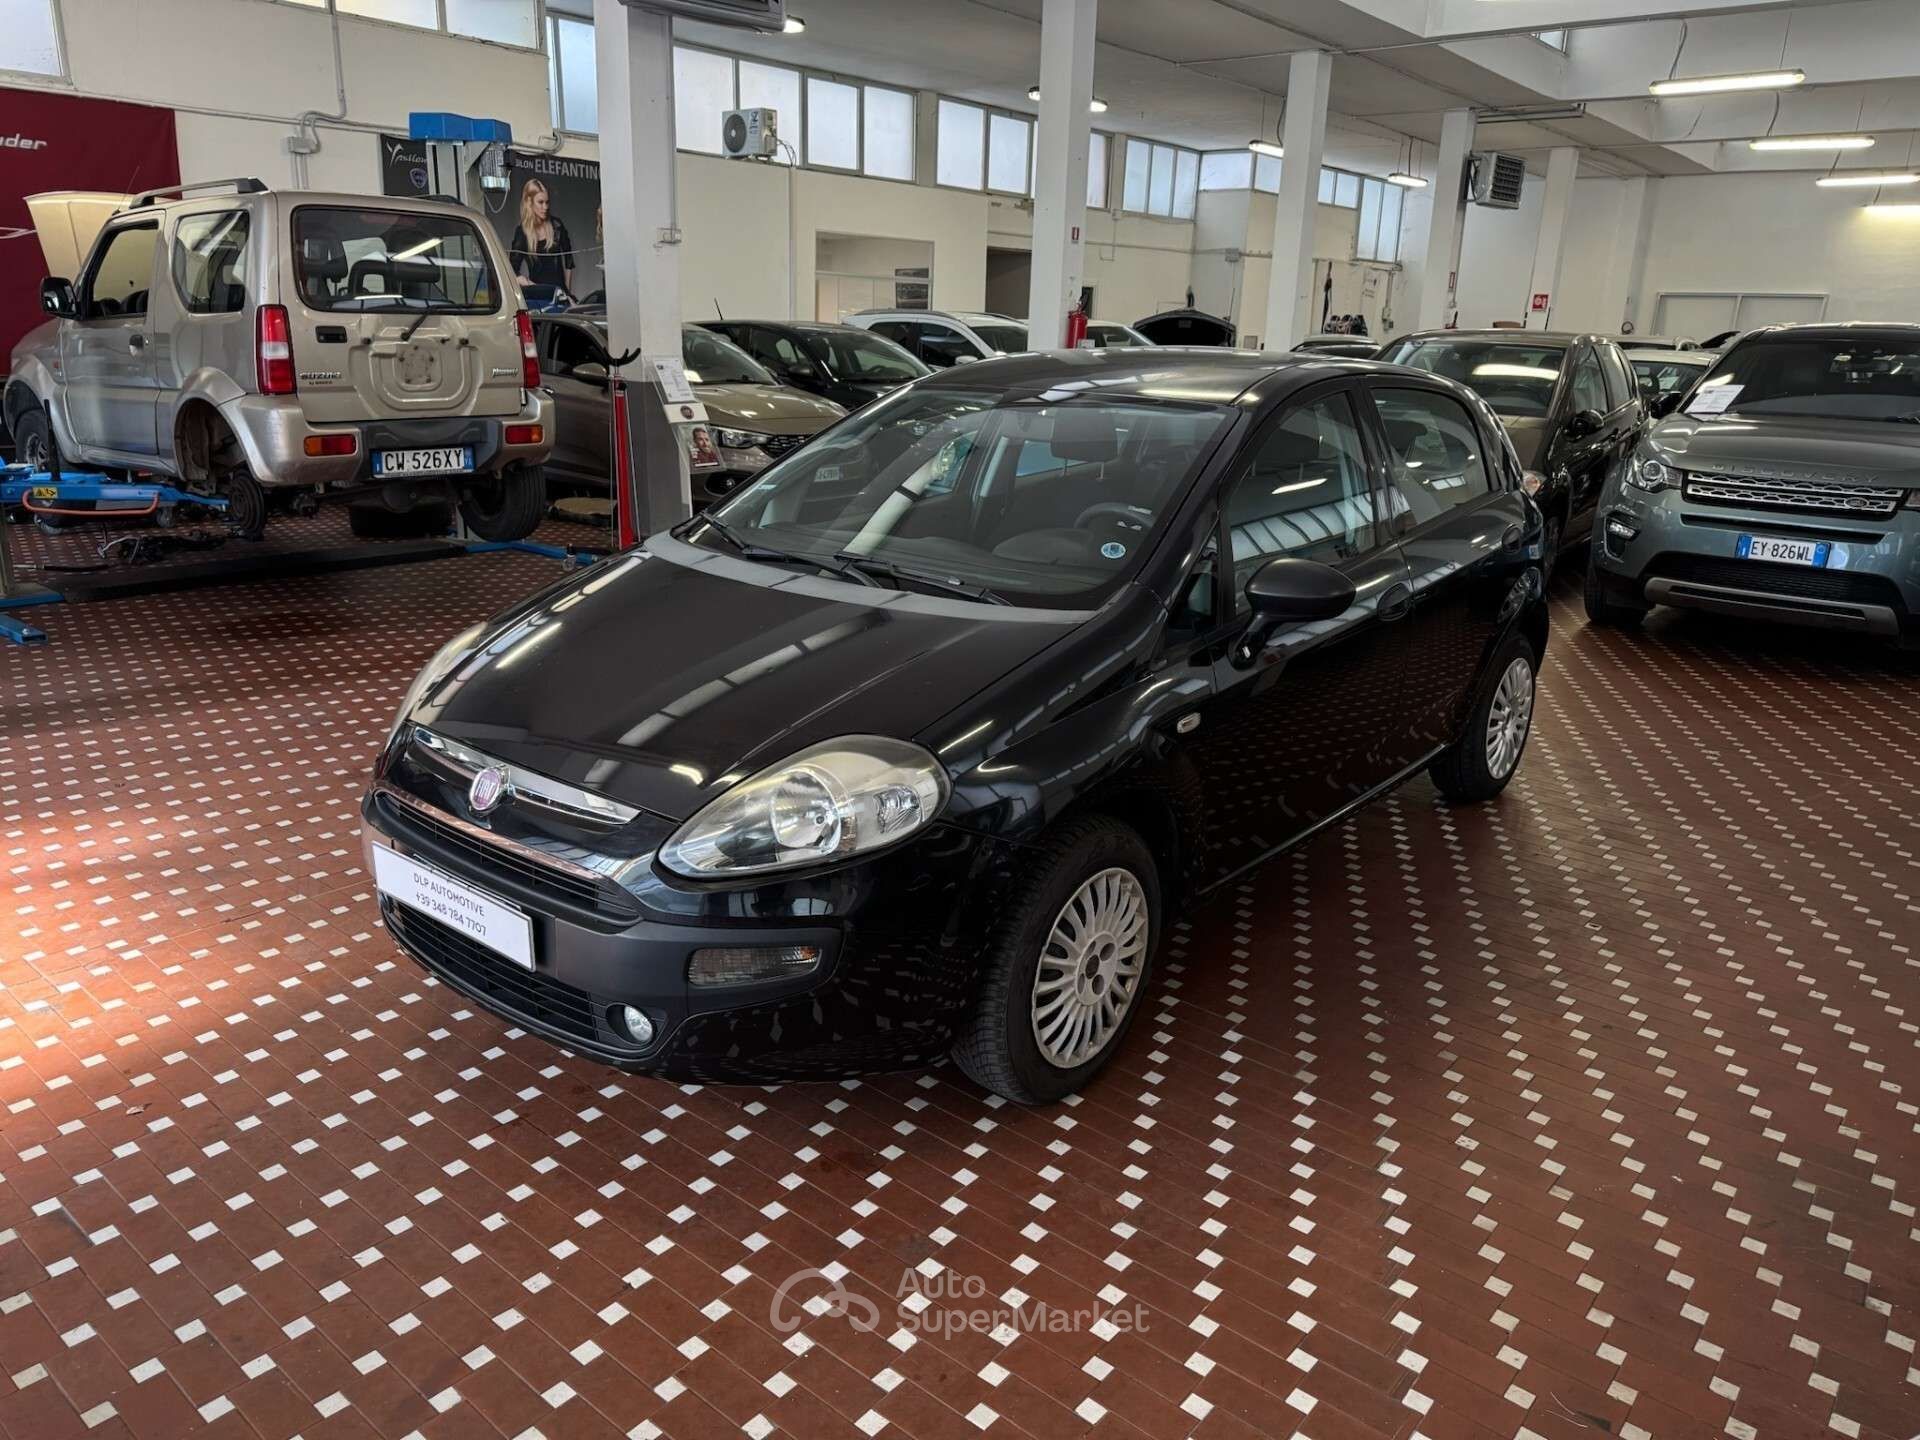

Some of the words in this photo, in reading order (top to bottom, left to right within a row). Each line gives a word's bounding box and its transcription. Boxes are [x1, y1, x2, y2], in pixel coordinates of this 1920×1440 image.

[535, 158, 600, 180] ELEFANTIN
[385, 452, 405, 471] CW
[412, 449, 462, 470] 526XY
[1751, 541, 1768, 556] EY
[1771, 543, 1812, 562] 826WL
[475, 777, 497, 801] FIAT
[413, 872, 429, 886] DLP
[430, 881, 485, 917] AUTOMOTIVE
[465, 916, 487, 937] 7707
